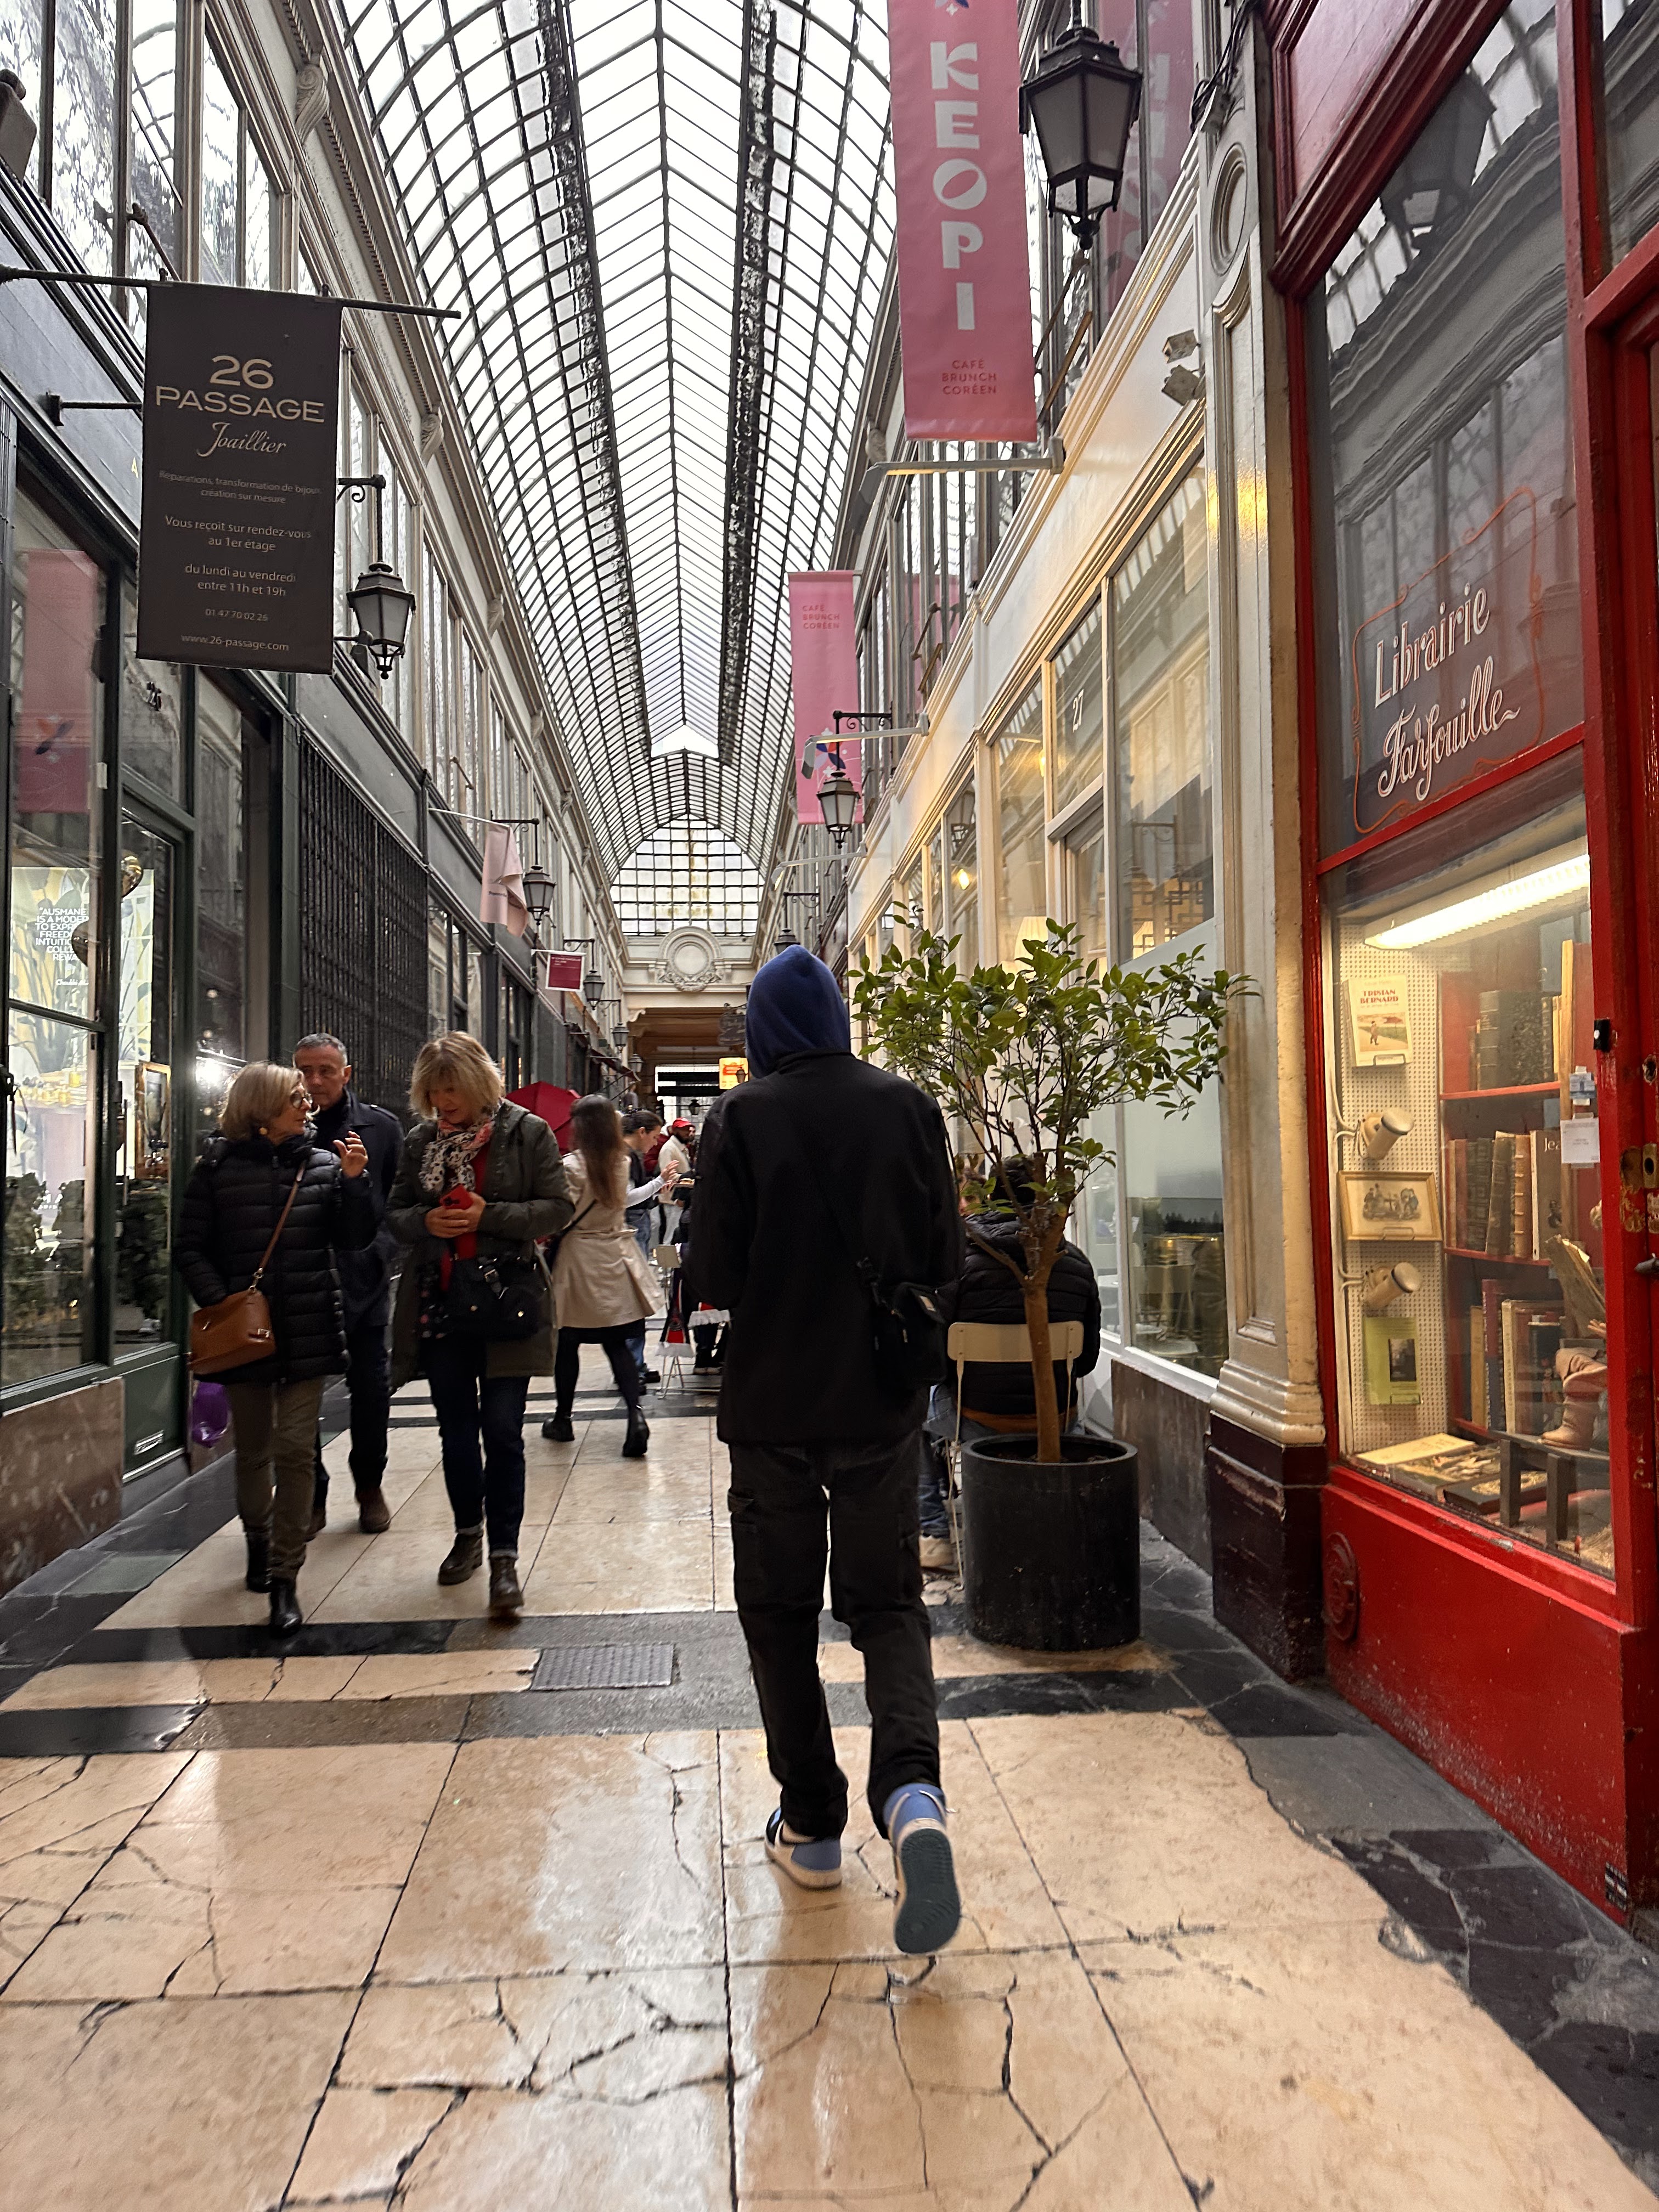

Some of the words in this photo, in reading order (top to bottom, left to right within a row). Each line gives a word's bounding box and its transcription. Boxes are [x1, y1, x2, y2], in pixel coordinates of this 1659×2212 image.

[929, 41, 988, 330] KEOPI
[210, 355, 274, 389] 26
[952, 358, 985, 369] CAFÉ
[941, 373, 997, 382] BRUNCH
[943, 383, 997, 395] CORÉEN
[155, 385, 324, 423] PASSAGE
[196, 422, 287, 458] Joaillier
[238, 492, 253, 501] sur
[165, 515, 193, 529] Vous
[195, 521, 225, 533] reçoit
[228, 523, 245, 533] sur
[247, 525, 312, 539] rendez-vous
[208, 537, 222, 546] au
[225, 537, 242, 548] 1er
[245, 539, 276, 553] étage
[184, 563, 200, 574] du
[202, 565, 231, 576] lundi
[233, 569, 246, 578] au
[249, 571, 296, 583] vendredi
[198, 581, 227, 591] entre
[229, 582, 250, 593] 11h
[252, 585, 263, 595] et
[266, 585, 286, 597] 19h
[180, 634, 290, 651] www.26-passage.com
[1374, 582, 1490, 709] Librairie
[1377, 655, 1521, 802] Farfouille
[1360, 996, 1399, 1004] BERNARD
[1362, 989, 1396, 997] TRISTAN
